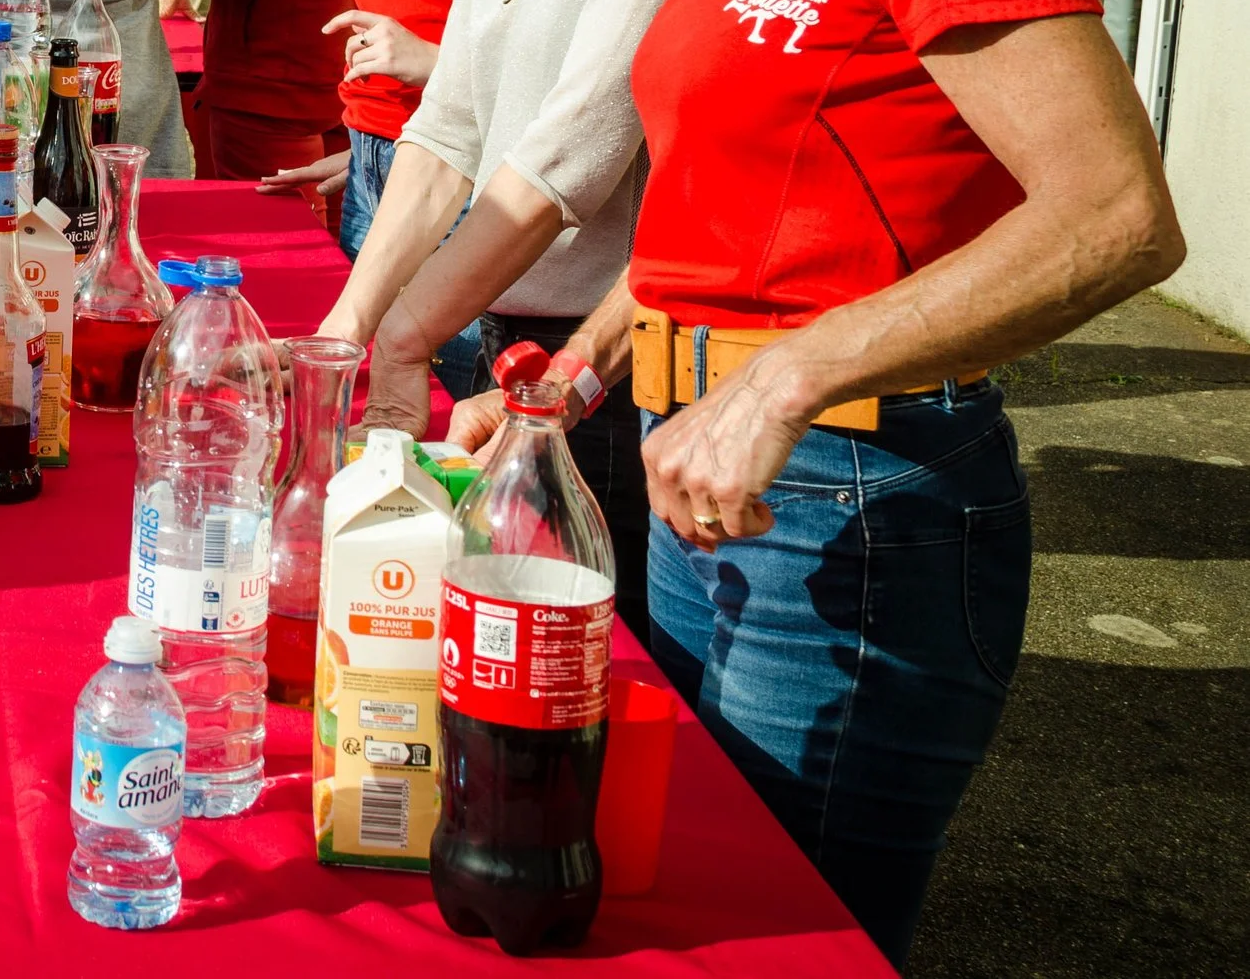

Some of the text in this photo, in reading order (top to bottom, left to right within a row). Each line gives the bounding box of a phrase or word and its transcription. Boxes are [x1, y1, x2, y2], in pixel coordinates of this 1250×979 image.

[44, 290, 60, 298] JUS
[136, 573, 155, 611] DES
[349, 602, 436, 617] 100% PUR JUS
[370, 619, 413, 630] ORANGE
[123, 761, 174, 790] Saint
